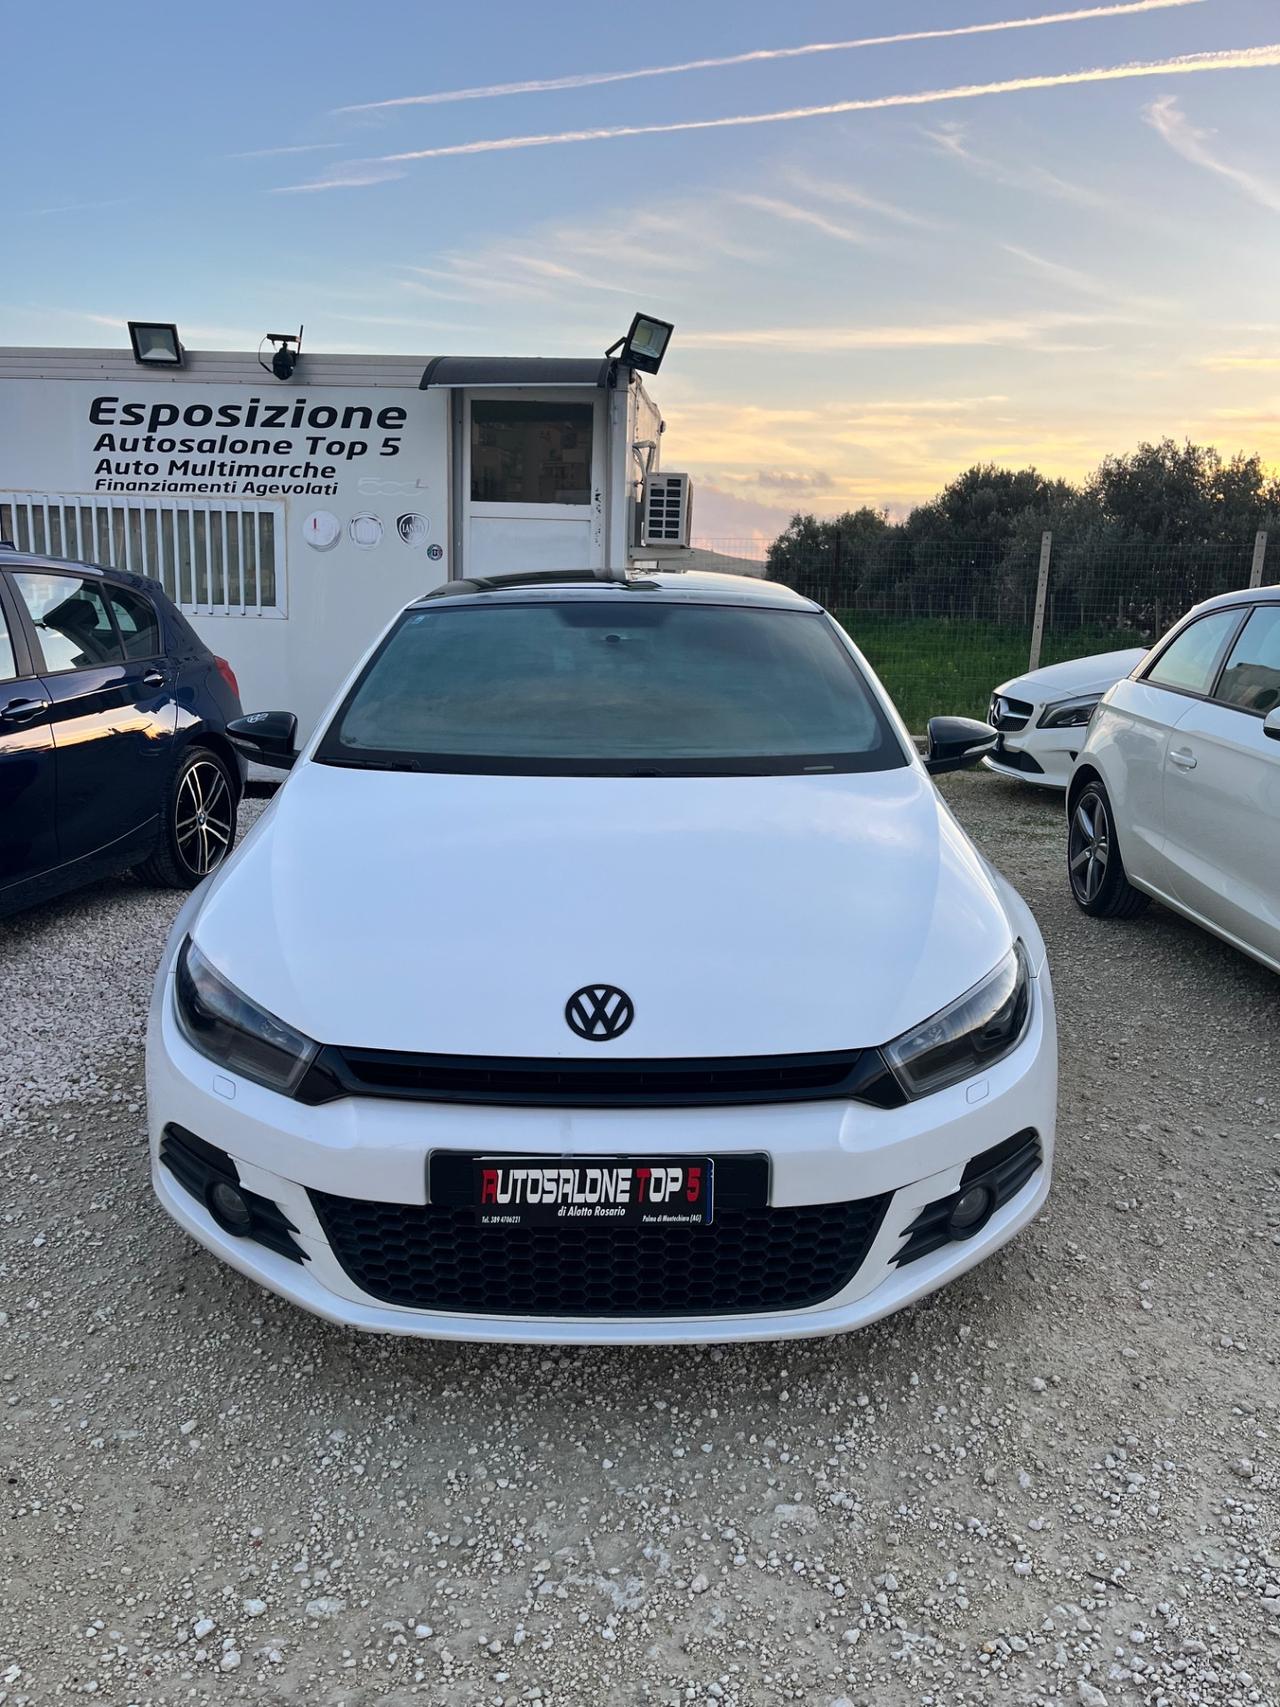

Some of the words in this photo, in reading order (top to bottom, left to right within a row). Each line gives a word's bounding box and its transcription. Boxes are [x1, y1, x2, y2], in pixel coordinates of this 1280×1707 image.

[89, 396, 408, 433] Esposizione
[93, 433, 293, 455] Autosalone
[305, 436, 369, 460] Top
[379, 437, 402, 457] 5
[94, 458, 159, 476] Auto
[167, 460, 337, 479] Multimarche
[95, 478, 238, 494] Finanziamenti
[242, 481, 339, 497] Agevolati
[482, 1168, 632, 1204] AUTOSALONE
[636, 1168, 683, 1203] TOP
[686, 1168, 701, 1202] 5
[481, 1216, 490, 1224] Tel.
[490, 1216, 500, 1224] 389
[557, 1206, 566, 1216] di
[594, 1206, 626, 1216] Rosario
[690, 1214, 702, 1223] (AG)
